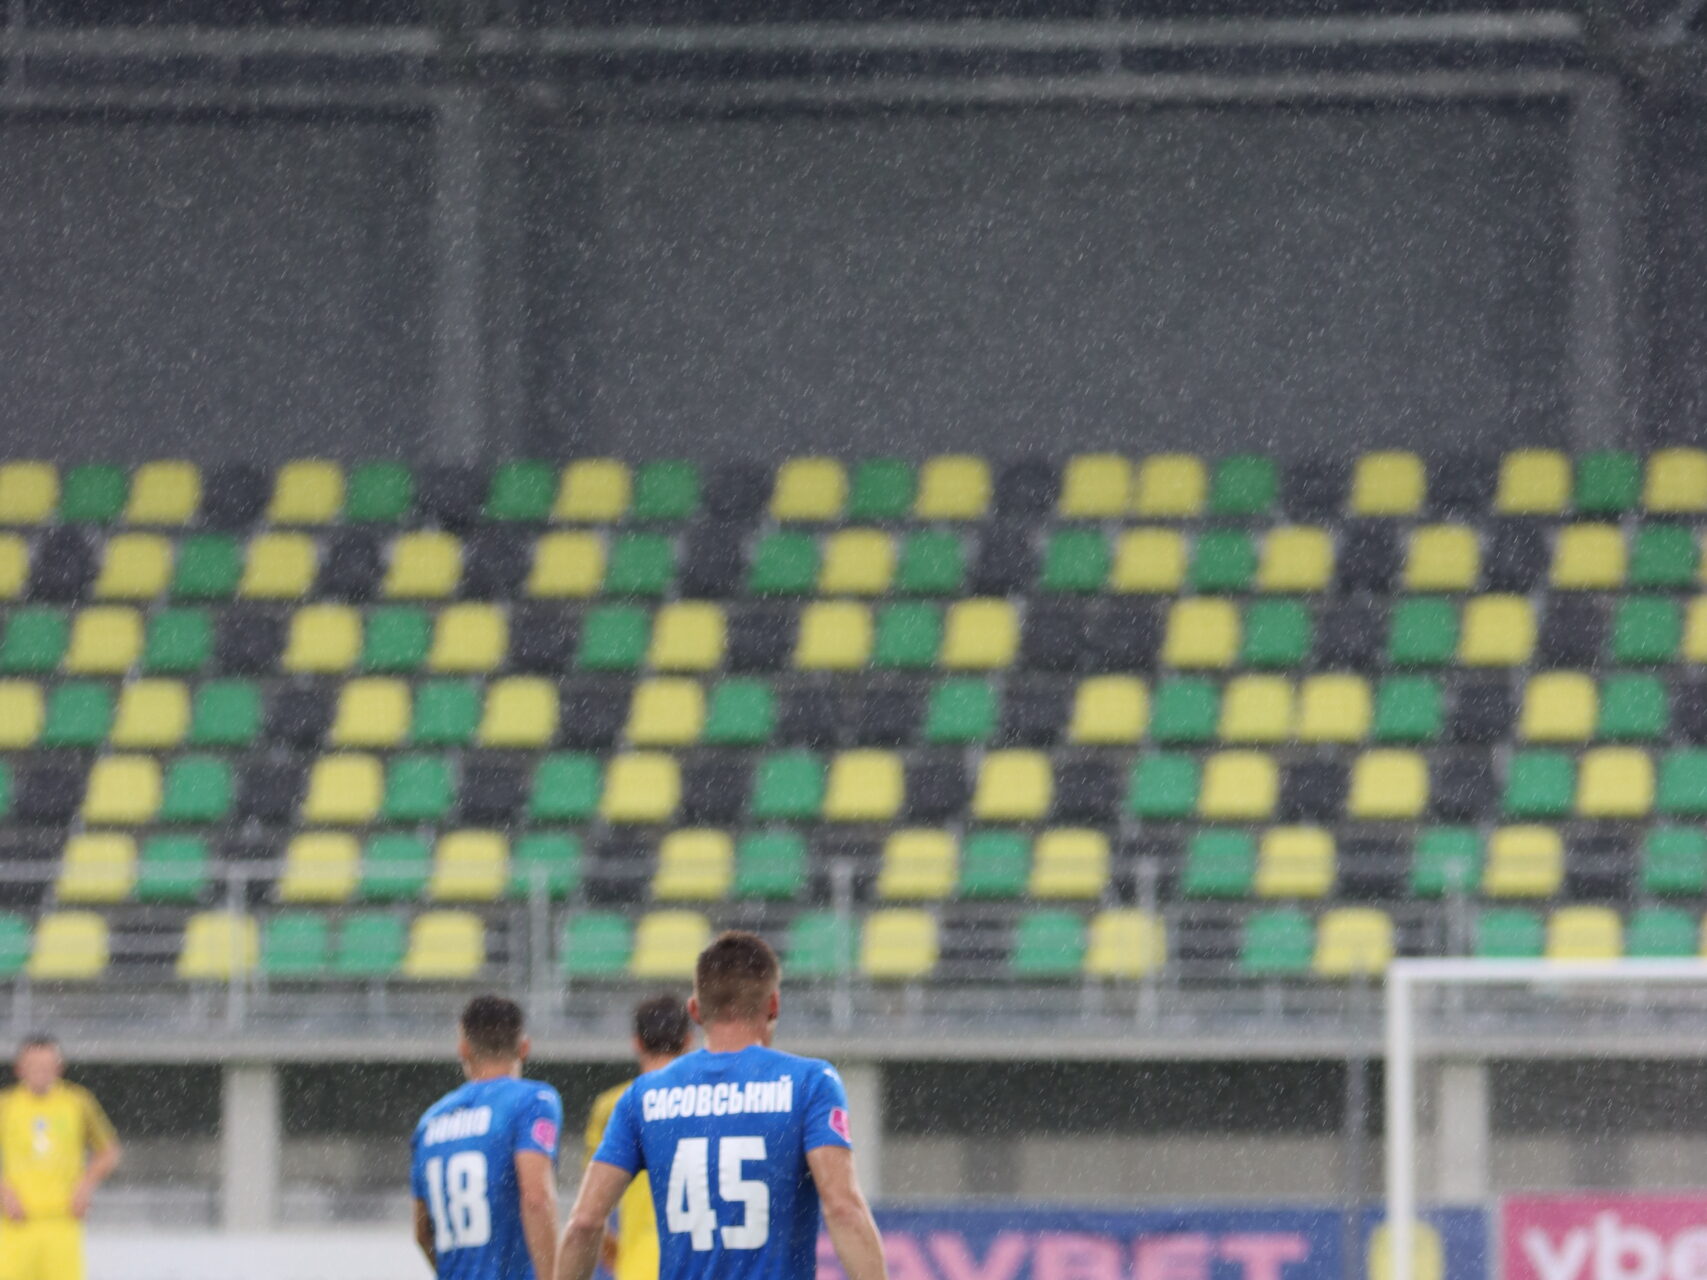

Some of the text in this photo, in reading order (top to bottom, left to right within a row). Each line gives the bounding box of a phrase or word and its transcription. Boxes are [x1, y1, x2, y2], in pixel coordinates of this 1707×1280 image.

[643, 1075, 793, 1122] САСОВСЬКИЙ
[426, 1151, 491, 1253] 18
[666, 1136, 770, 1251] 45
